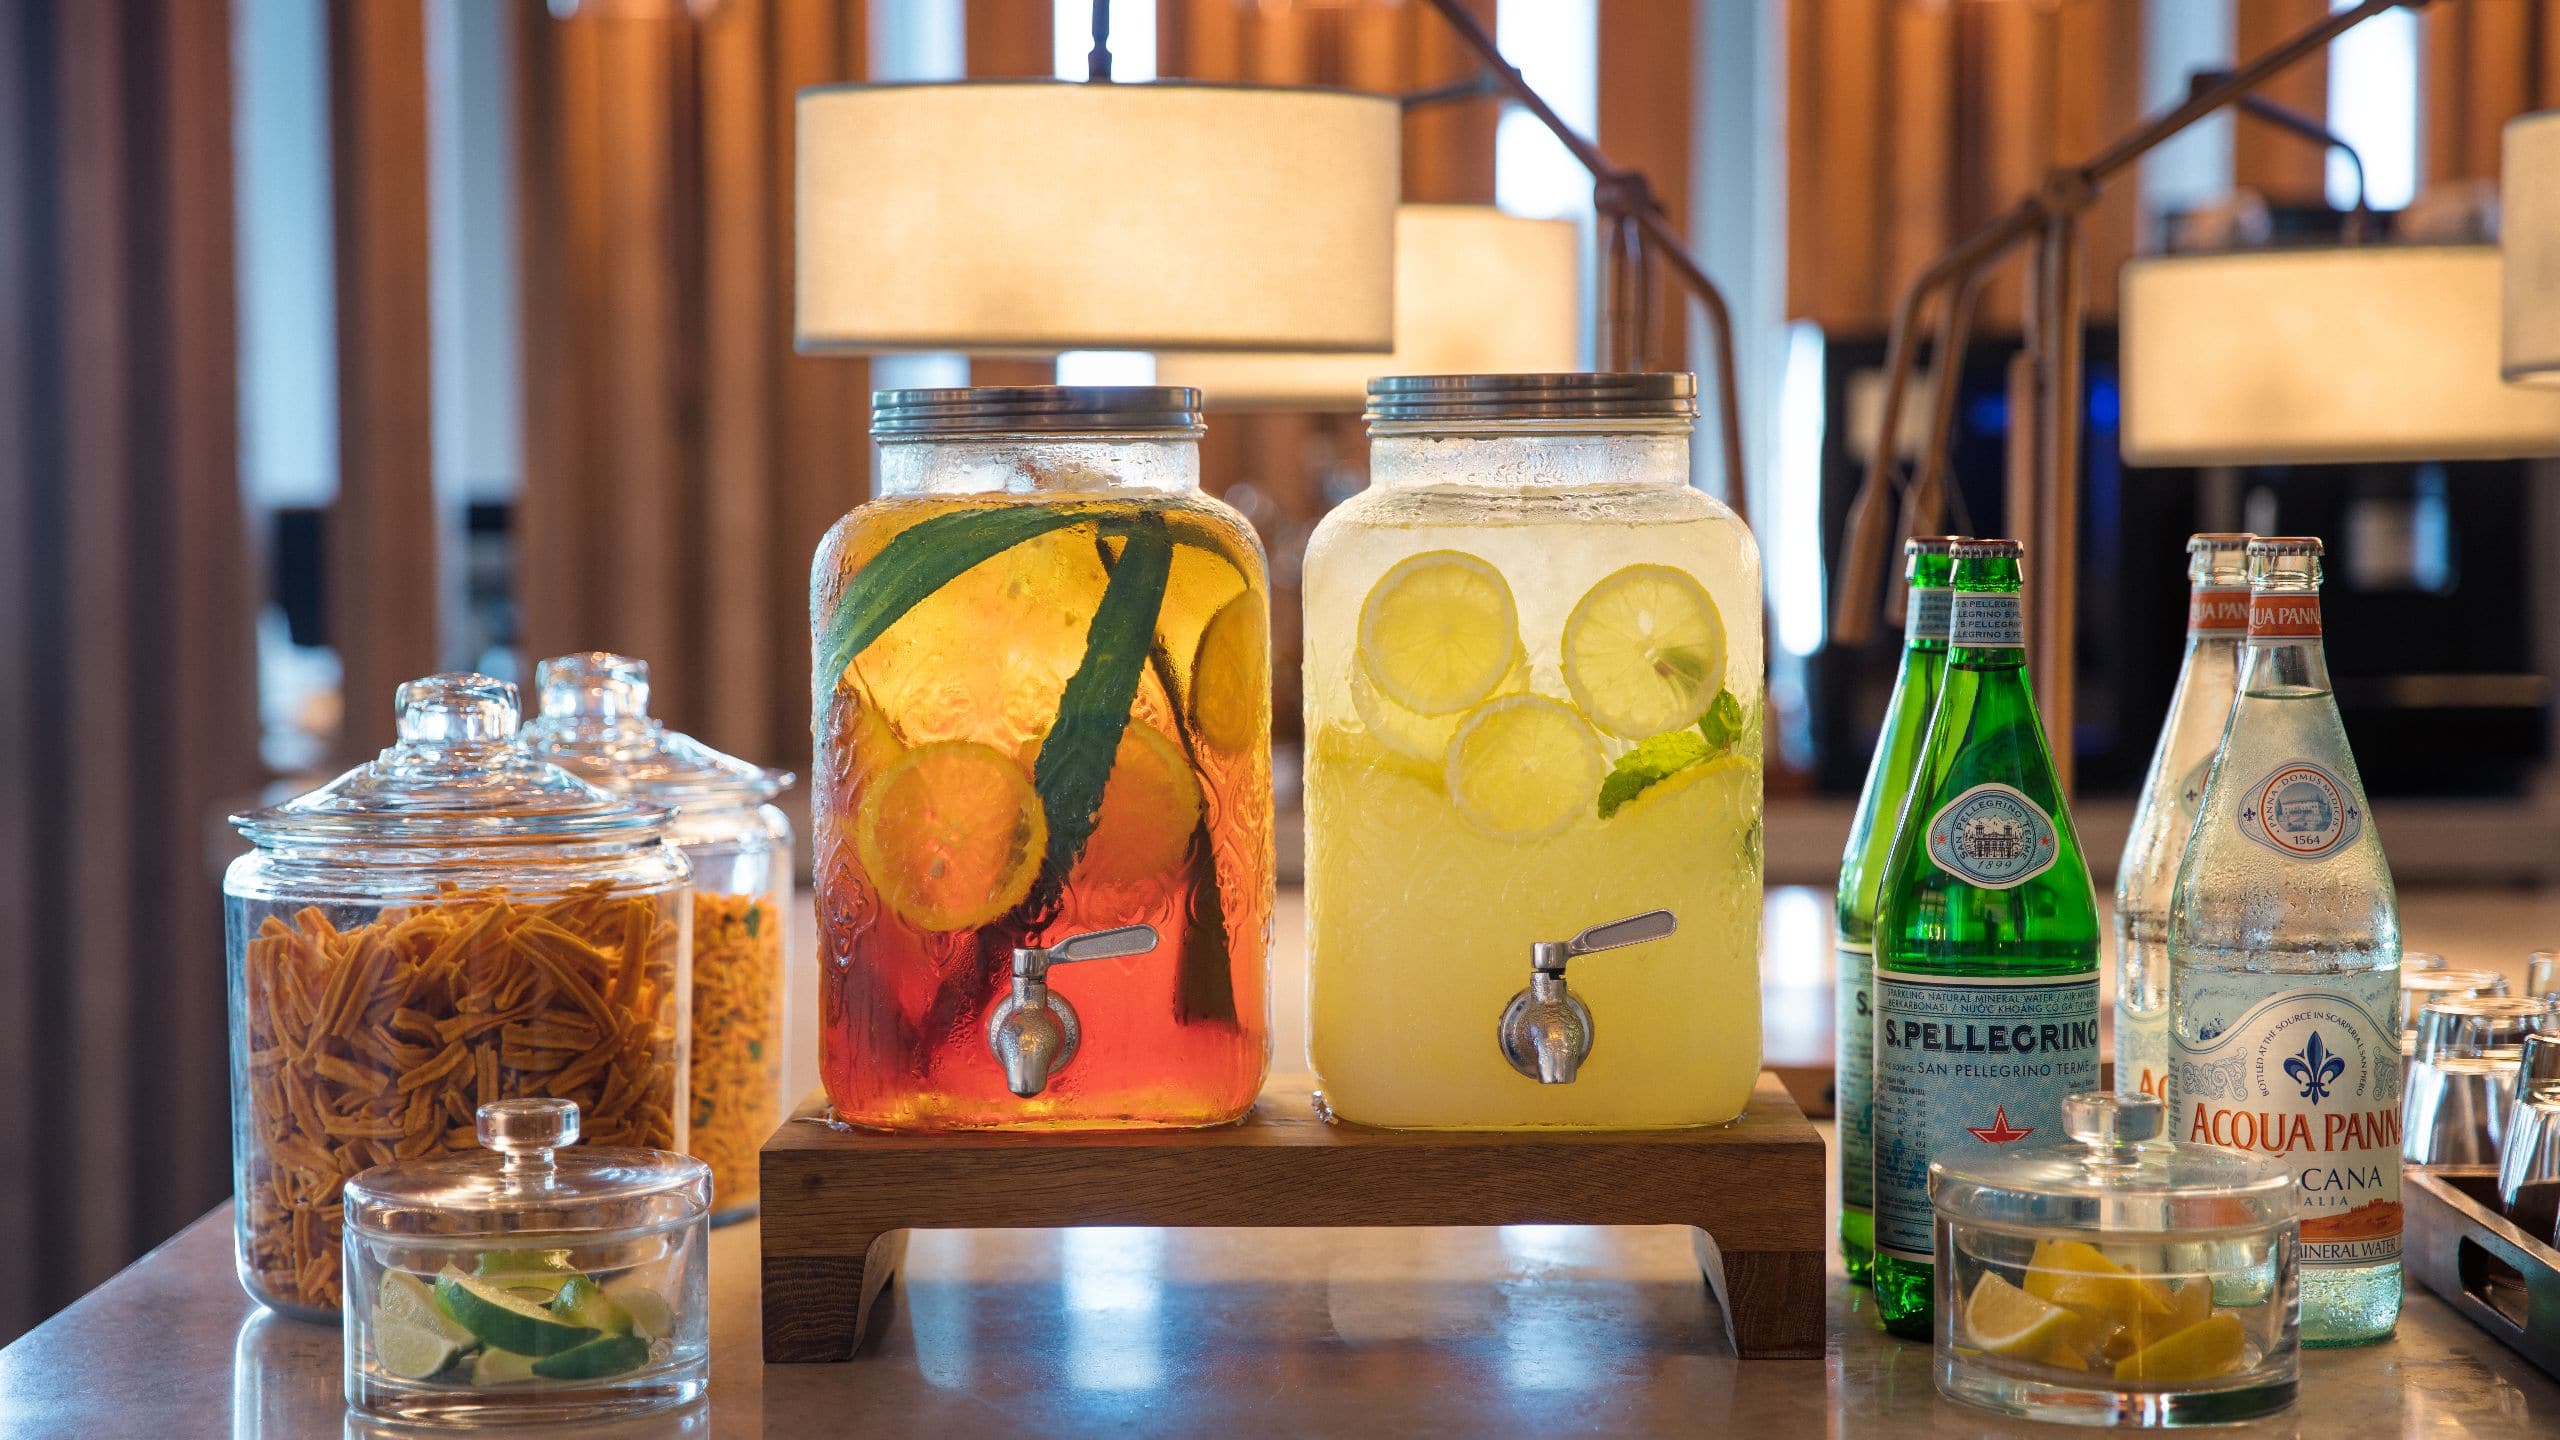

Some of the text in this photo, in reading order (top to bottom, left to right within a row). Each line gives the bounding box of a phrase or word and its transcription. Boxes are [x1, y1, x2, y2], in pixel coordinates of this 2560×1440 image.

[2278, 607, 2321, 625] PANN
[2266, 774, 2340, 829] PANNA DOMUS MEDICIS
[1956, 800, 2033, 861] SAN PELLEGRINO TERME
[2293, 835, 2320, 845] 1564
[1977, 860, 2012, 870] 1899
[1887, 988, 1925, 1000] SPARKLING
[1928, 992, 1971, 1002] NATURAL
[1975, 993, 2020, 1003] MINERAL
[2024, 993, 2054, 1002] WATER
[2276, 1011, 2312, 1032] SOURCE
[2325, 1012, 2361, 1045] SCARPERIA
[2263, 1030, 2277, 1045] THE
[2259, 1045, 2267, 1056] AT
[2359, 1050, 2367, 1069] SAN
[1918, 1062, 1947, 1075] SAN
[1956, 1064, 2050, 1077] PELLEGRINO
[2057, 1060, 2089, 1075] TERME
[2256, 1057, 2270, 1097] BOTTLED
[2190, 1102, 2316, 1158] ACQUA
[2361, 1238, 2396, 1257] WATER
